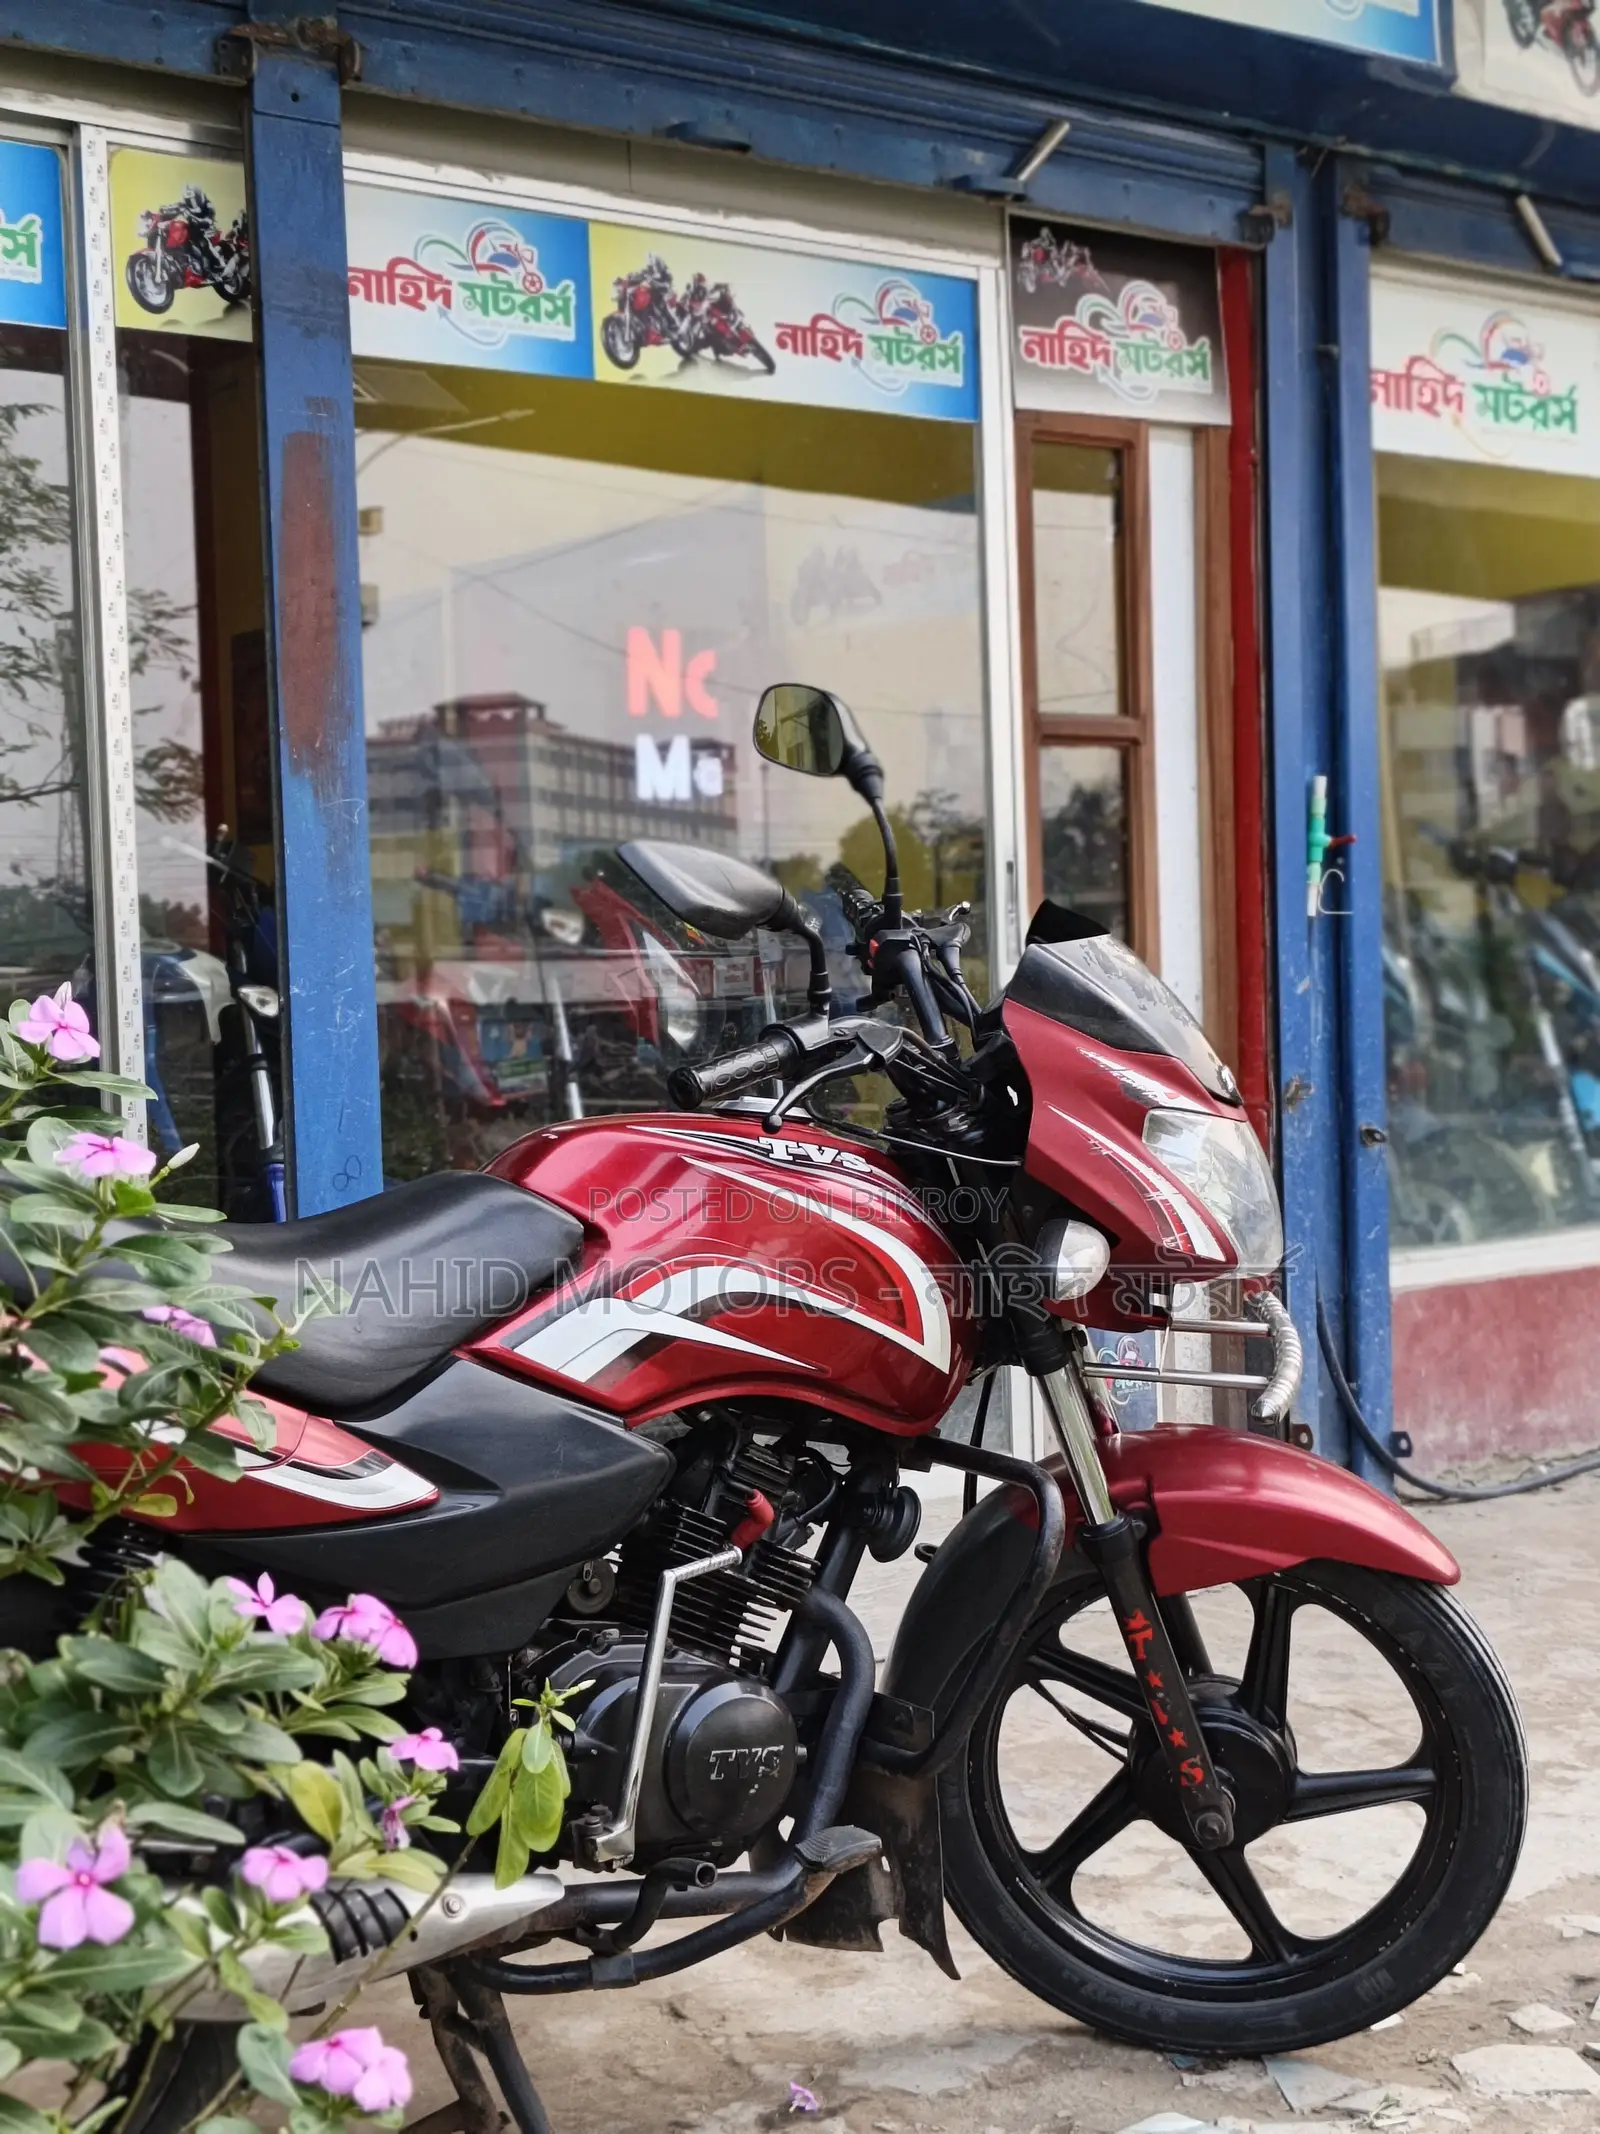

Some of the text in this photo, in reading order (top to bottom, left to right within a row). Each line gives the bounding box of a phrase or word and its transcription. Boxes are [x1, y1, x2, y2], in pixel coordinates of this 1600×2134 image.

[347, 256, 452, 312] নাহিদ
[775, 314, 864, 362] নাহিদ
[1020, 320, 1112, 372] নাহিদ
[758, 1136, 872, 1173] TVS
